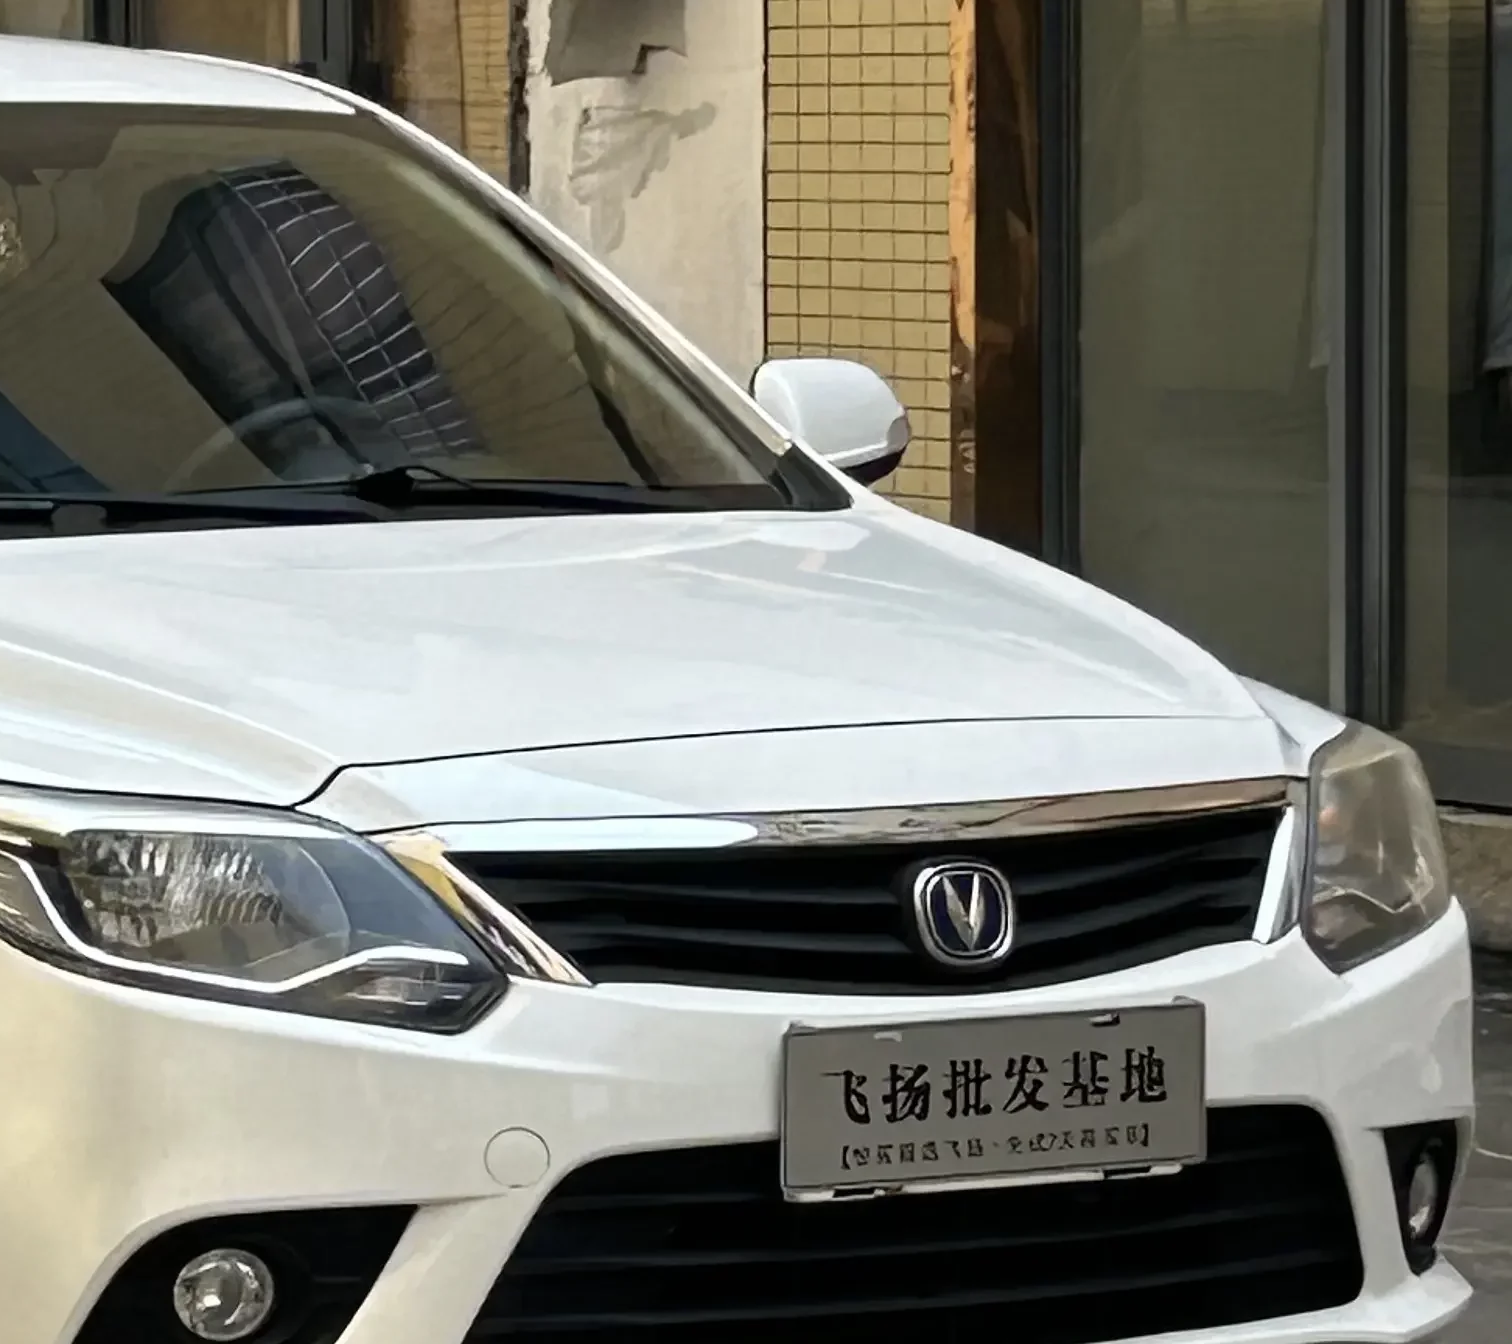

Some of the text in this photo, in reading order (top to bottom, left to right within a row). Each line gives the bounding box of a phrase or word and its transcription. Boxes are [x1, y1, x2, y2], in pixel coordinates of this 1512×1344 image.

[821, 1046, 1168, 1124] 飞扬批发基地
